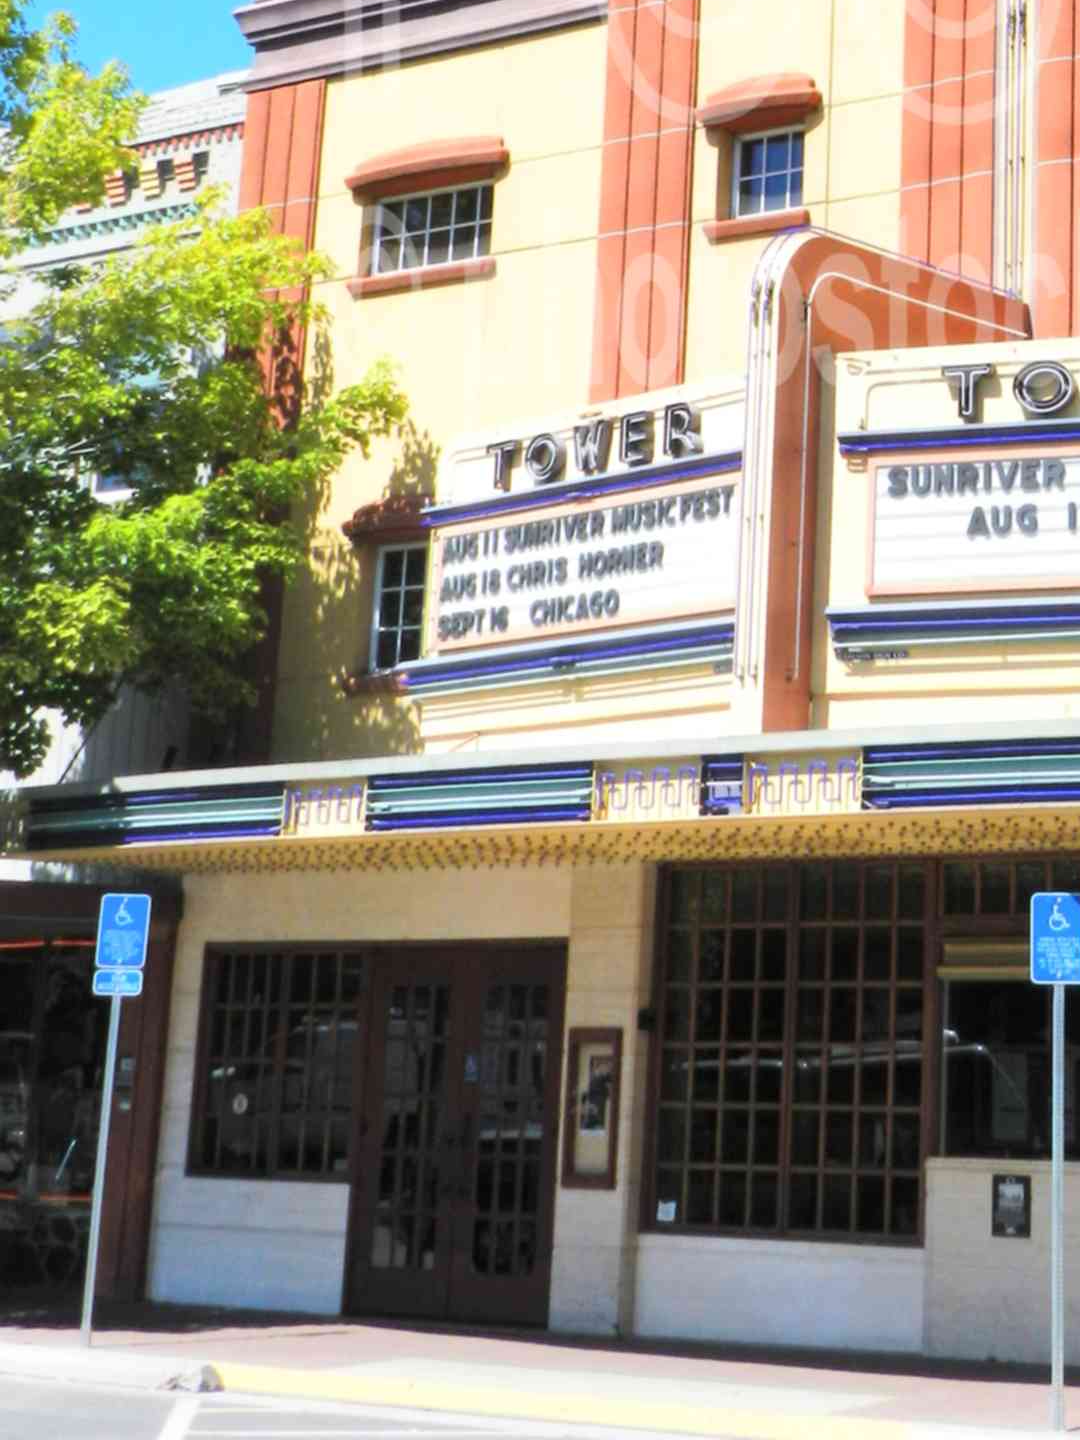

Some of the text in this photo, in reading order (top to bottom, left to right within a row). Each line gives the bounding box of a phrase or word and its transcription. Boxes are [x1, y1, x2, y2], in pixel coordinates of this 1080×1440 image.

[485, 401, 704, 491] TOWER
[887, 450, 1066, 498] SUNRIVER
[442, 485, 735, 565] AUG 11 SUNRIVER MUSIC FEST
[966, 503, 1039, 538] AUG
[440, 540, 665, 603] AUG 18 CHRIS HORNER
[437, 608, 485, 642] SEPT
[529, 588, 621, 627] CHICAGO
